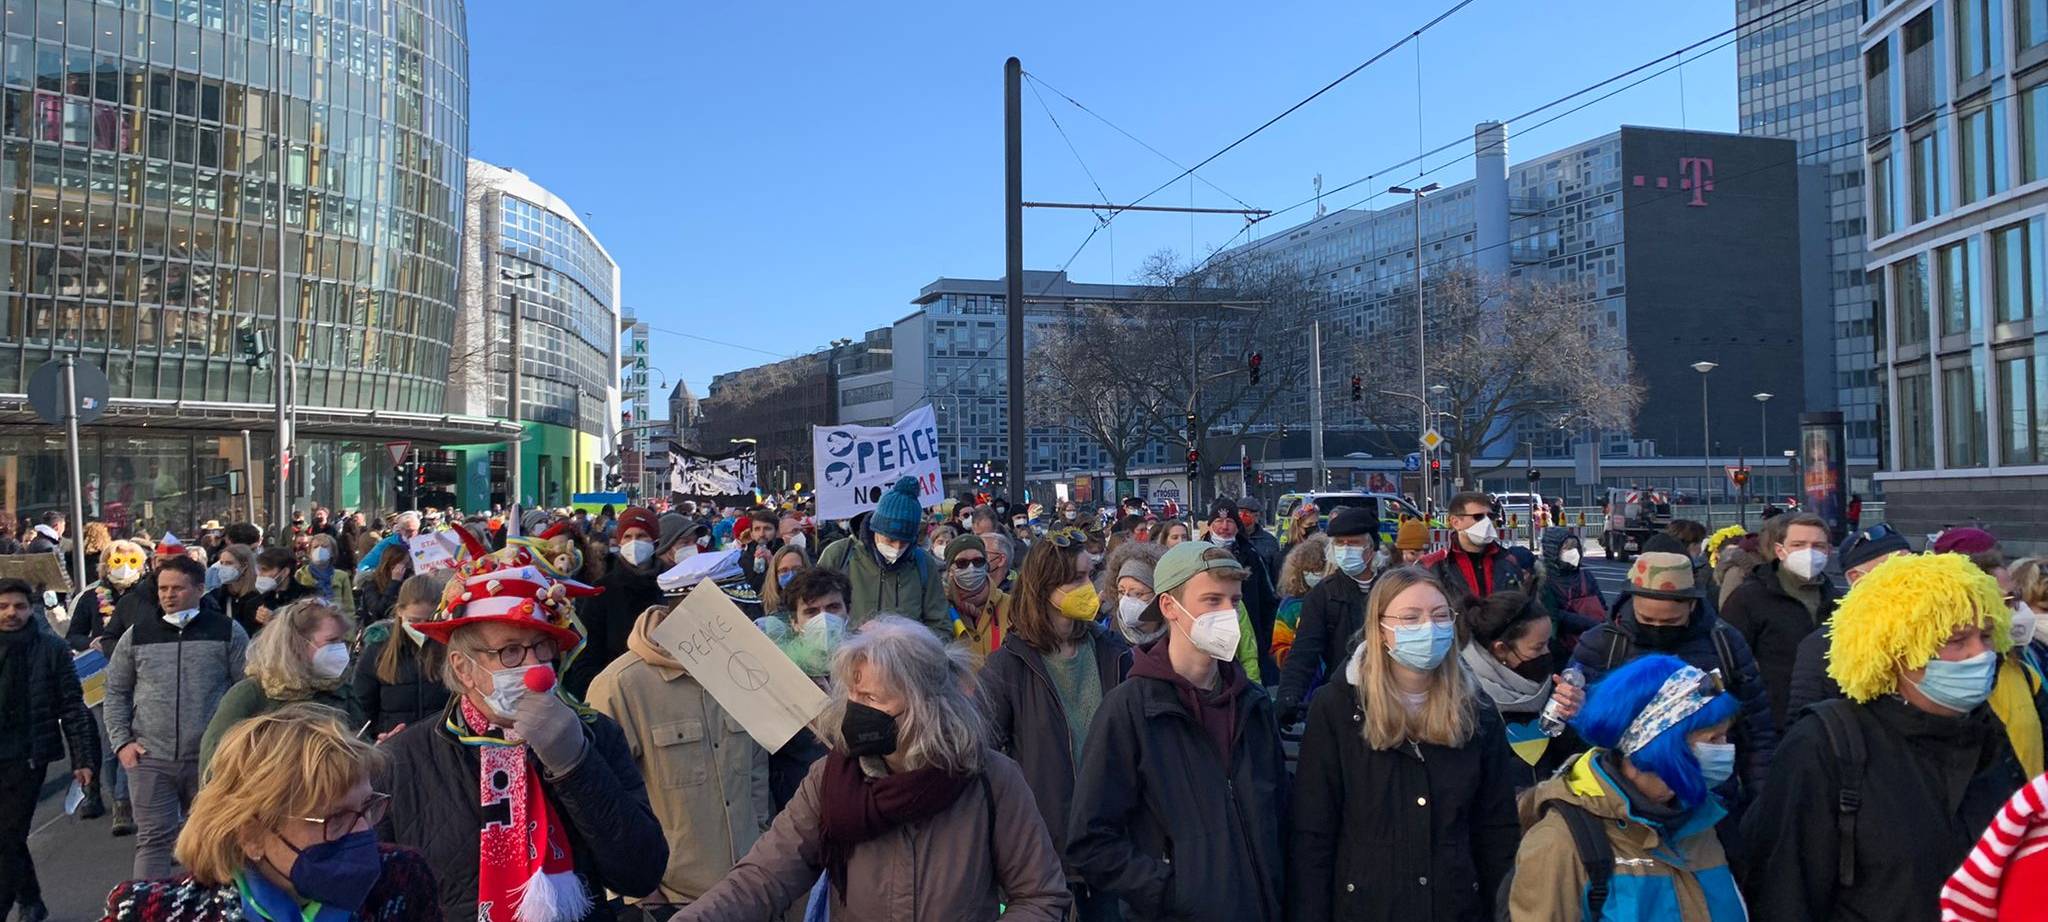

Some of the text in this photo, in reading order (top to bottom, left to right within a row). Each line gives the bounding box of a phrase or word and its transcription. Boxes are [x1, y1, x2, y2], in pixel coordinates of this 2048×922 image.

[1680, 157, 1713, 206] T
[857, 427, 938, 474] PEACE
[917, 472, 938, 496] AR
[678, 615, 732, 664] PEACE
